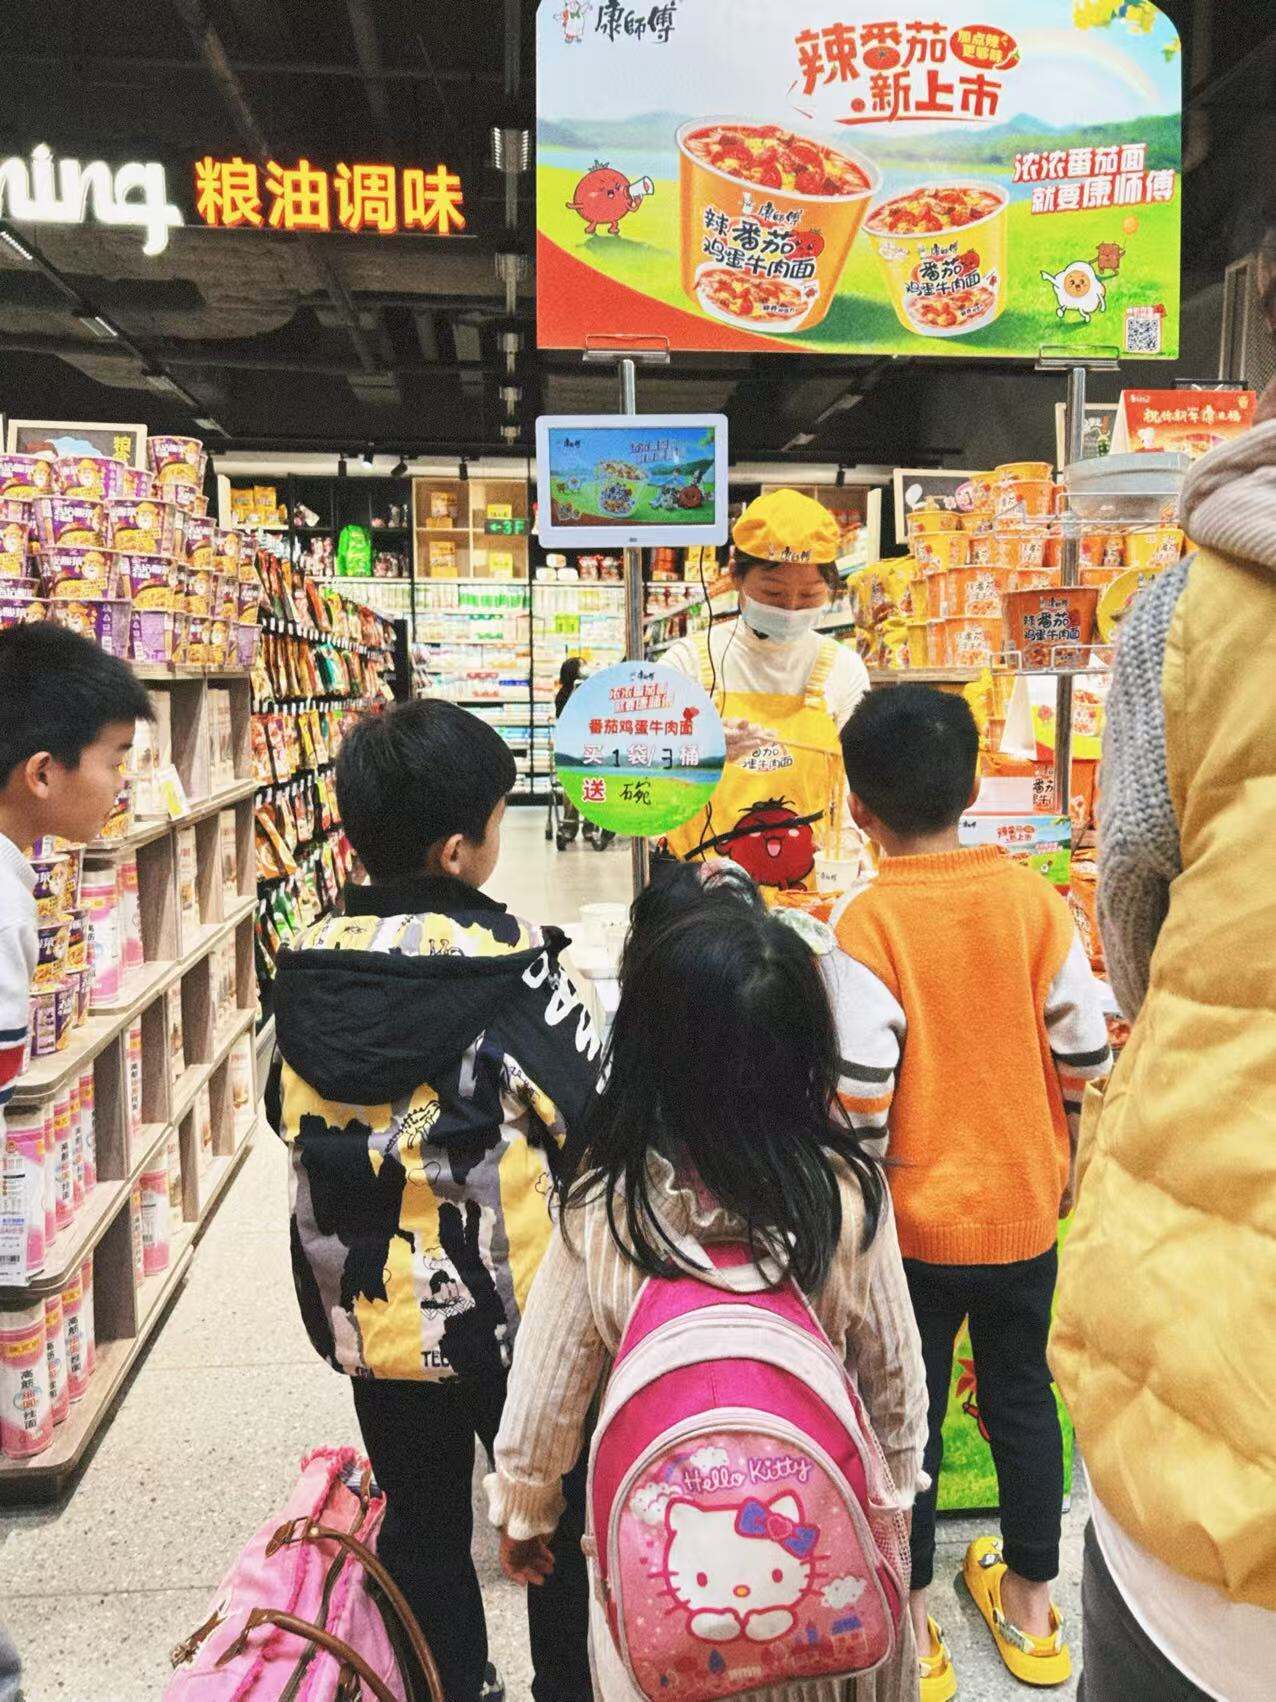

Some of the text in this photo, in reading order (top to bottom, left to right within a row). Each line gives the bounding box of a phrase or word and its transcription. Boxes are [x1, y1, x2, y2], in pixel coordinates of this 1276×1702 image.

[795, 20, 948, 95] 辣番茄
[868, 70, 1002, 122] 新上市
[1013, 143, 1148, 183] 浓浓番茄面
[195, 156, 466, 236] 粮油调味
[1031, 169, 1176, 214] 就要康师傅
[703, 236, 816, 280] 鸡蛋牛肉面
[919, 258, 963, 281] 番茄
[905, 269, 981, 296] 鸡蛋牛肉面
[588, 718, 694, 736] 番茄鸡蛋牛肉面
[683, 1454, 813, 1493] Hello Kitty
